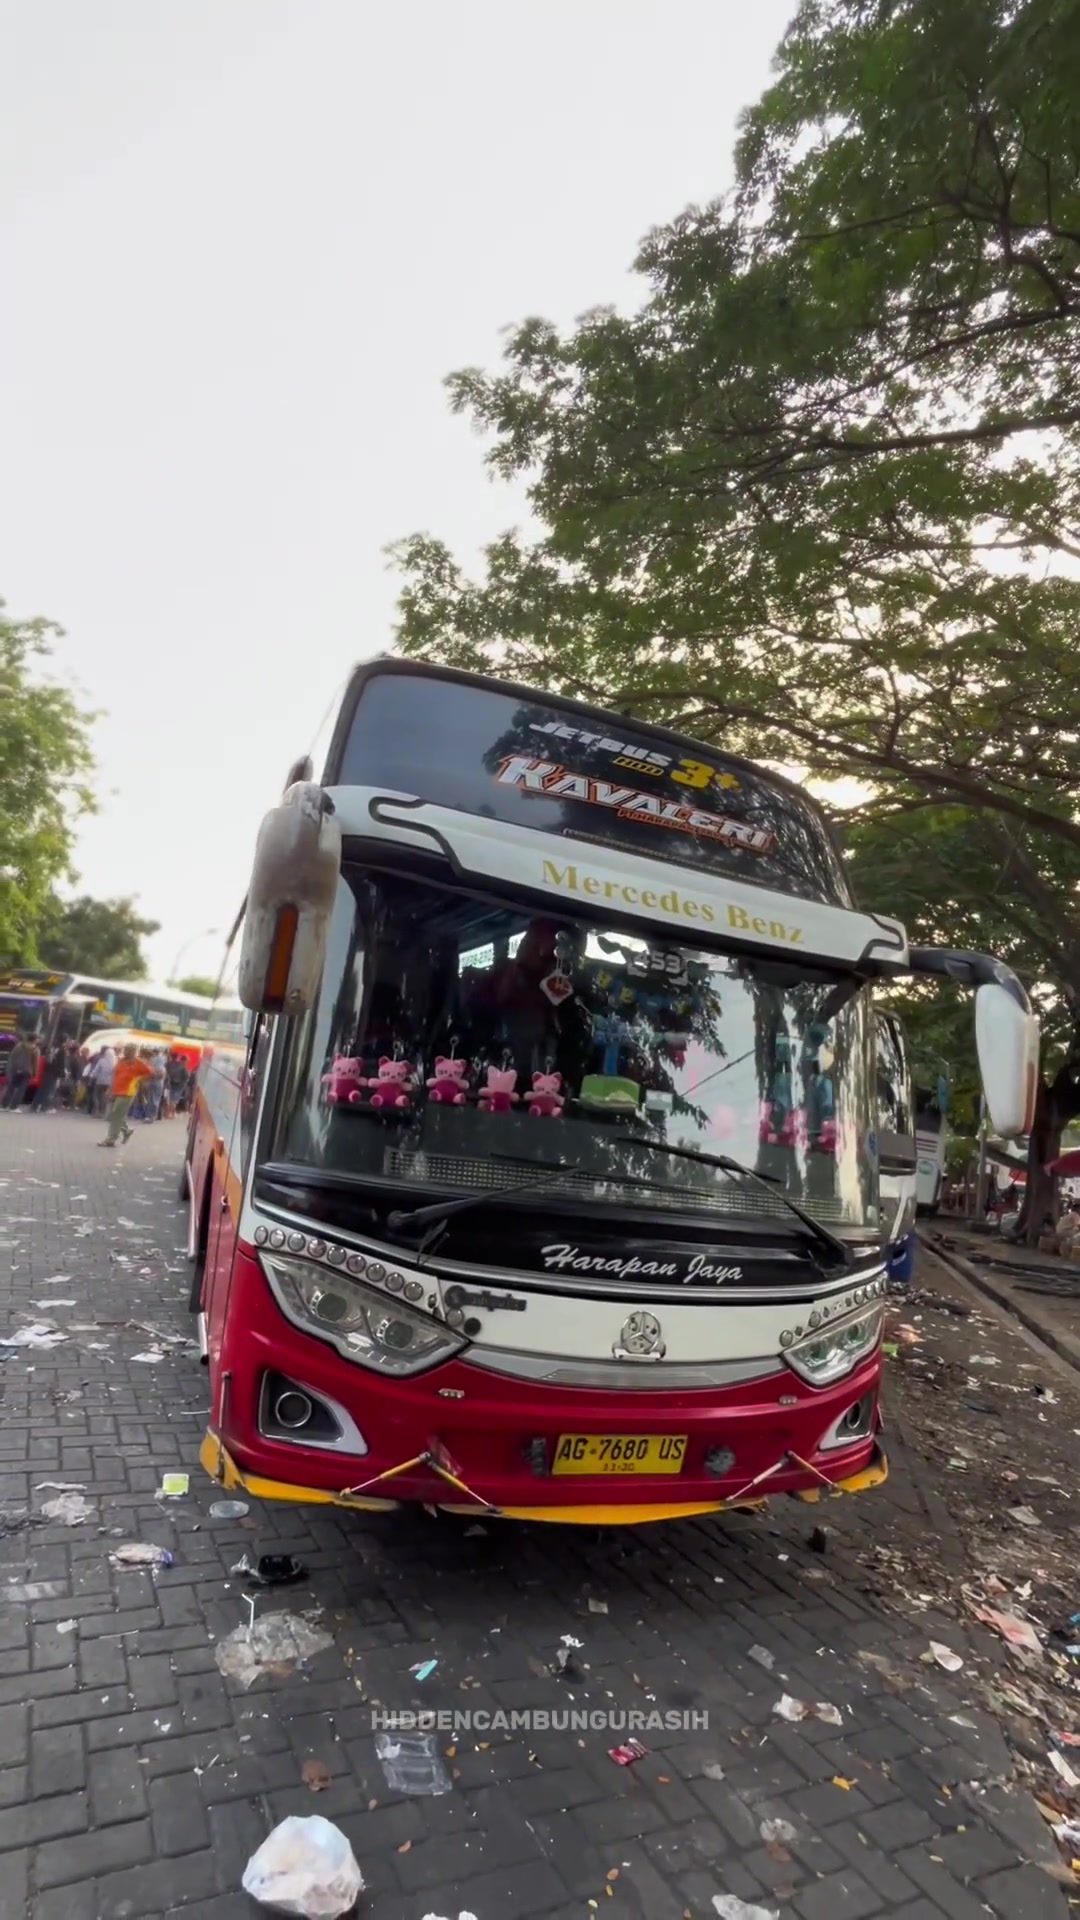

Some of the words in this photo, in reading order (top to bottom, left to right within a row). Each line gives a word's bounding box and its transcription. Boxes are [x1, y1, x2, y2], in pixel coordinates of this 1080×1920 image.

[529, 722, 673, 767] JETBUS
[541, 860, 714, 922] Mercedes
[726, 903, 805, 944] Benz
[541, 1244, 677, 1278] Harapan
[683, 1254, 743, 1284] Jaya
[557, 1438, 589, 1461] AG
[599, 1438, 649, 1461] 7680
[658, 1438, 685, 1460] US
